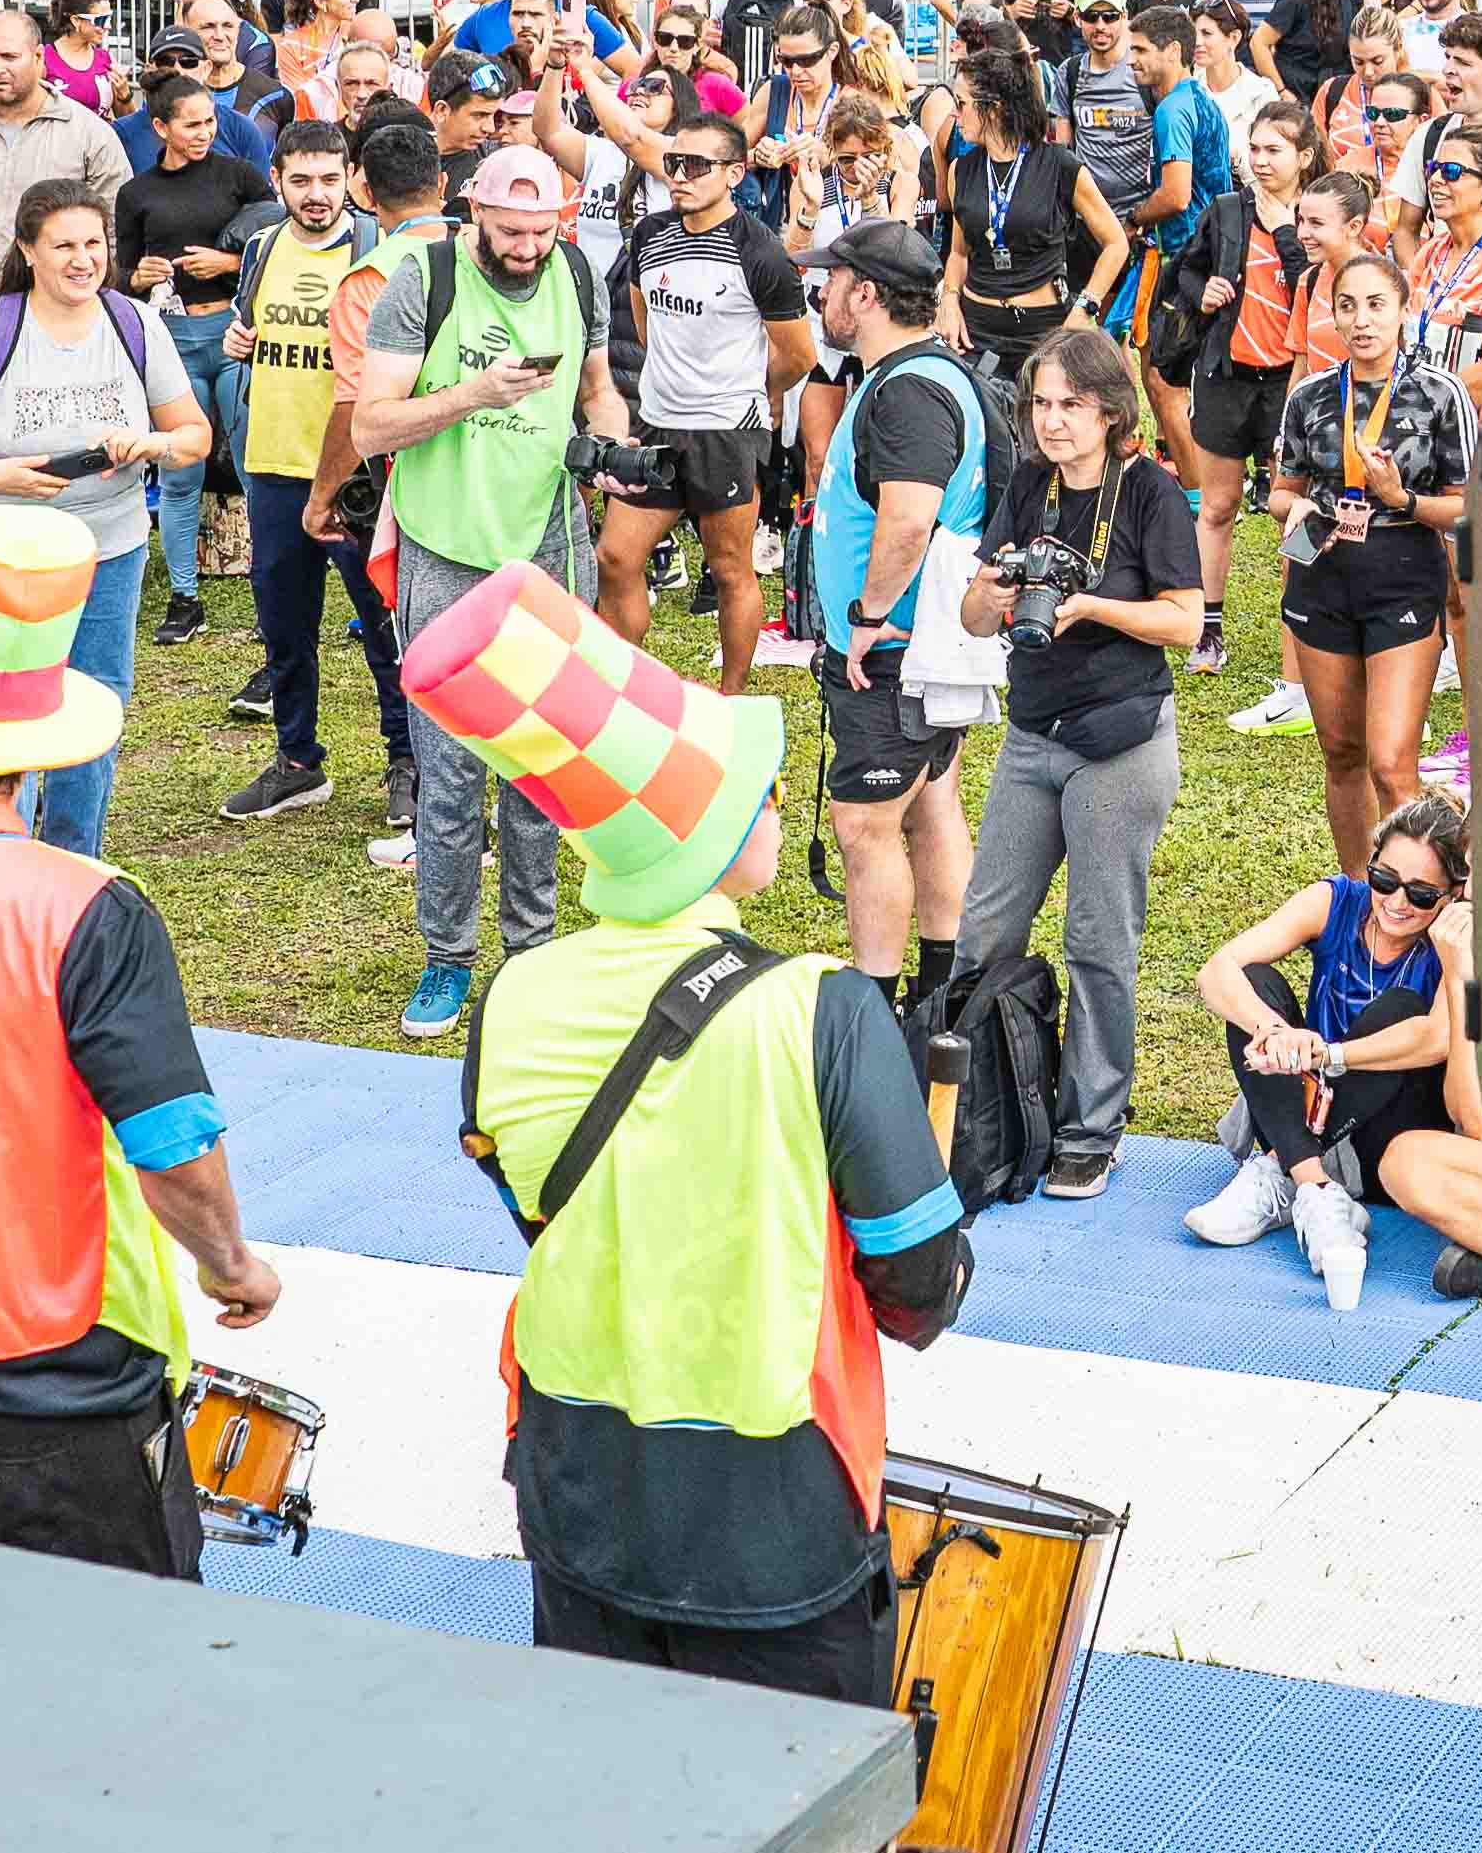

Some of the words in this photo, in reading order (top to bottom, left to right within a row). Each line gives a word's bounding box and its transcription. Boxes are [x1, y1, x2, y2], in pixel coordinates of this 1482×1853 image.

[1112, 116, 1136, 129] 2024
[579, 195, 649, 224] adids
[263, 303, 330, 330] SONDE
[649, 287, 705, 317] ATENAS
[257, 340, 334, 371] PRENS
[459, 344, 495, 373] SON
[1093, 519, 1110, 560] Nikon
